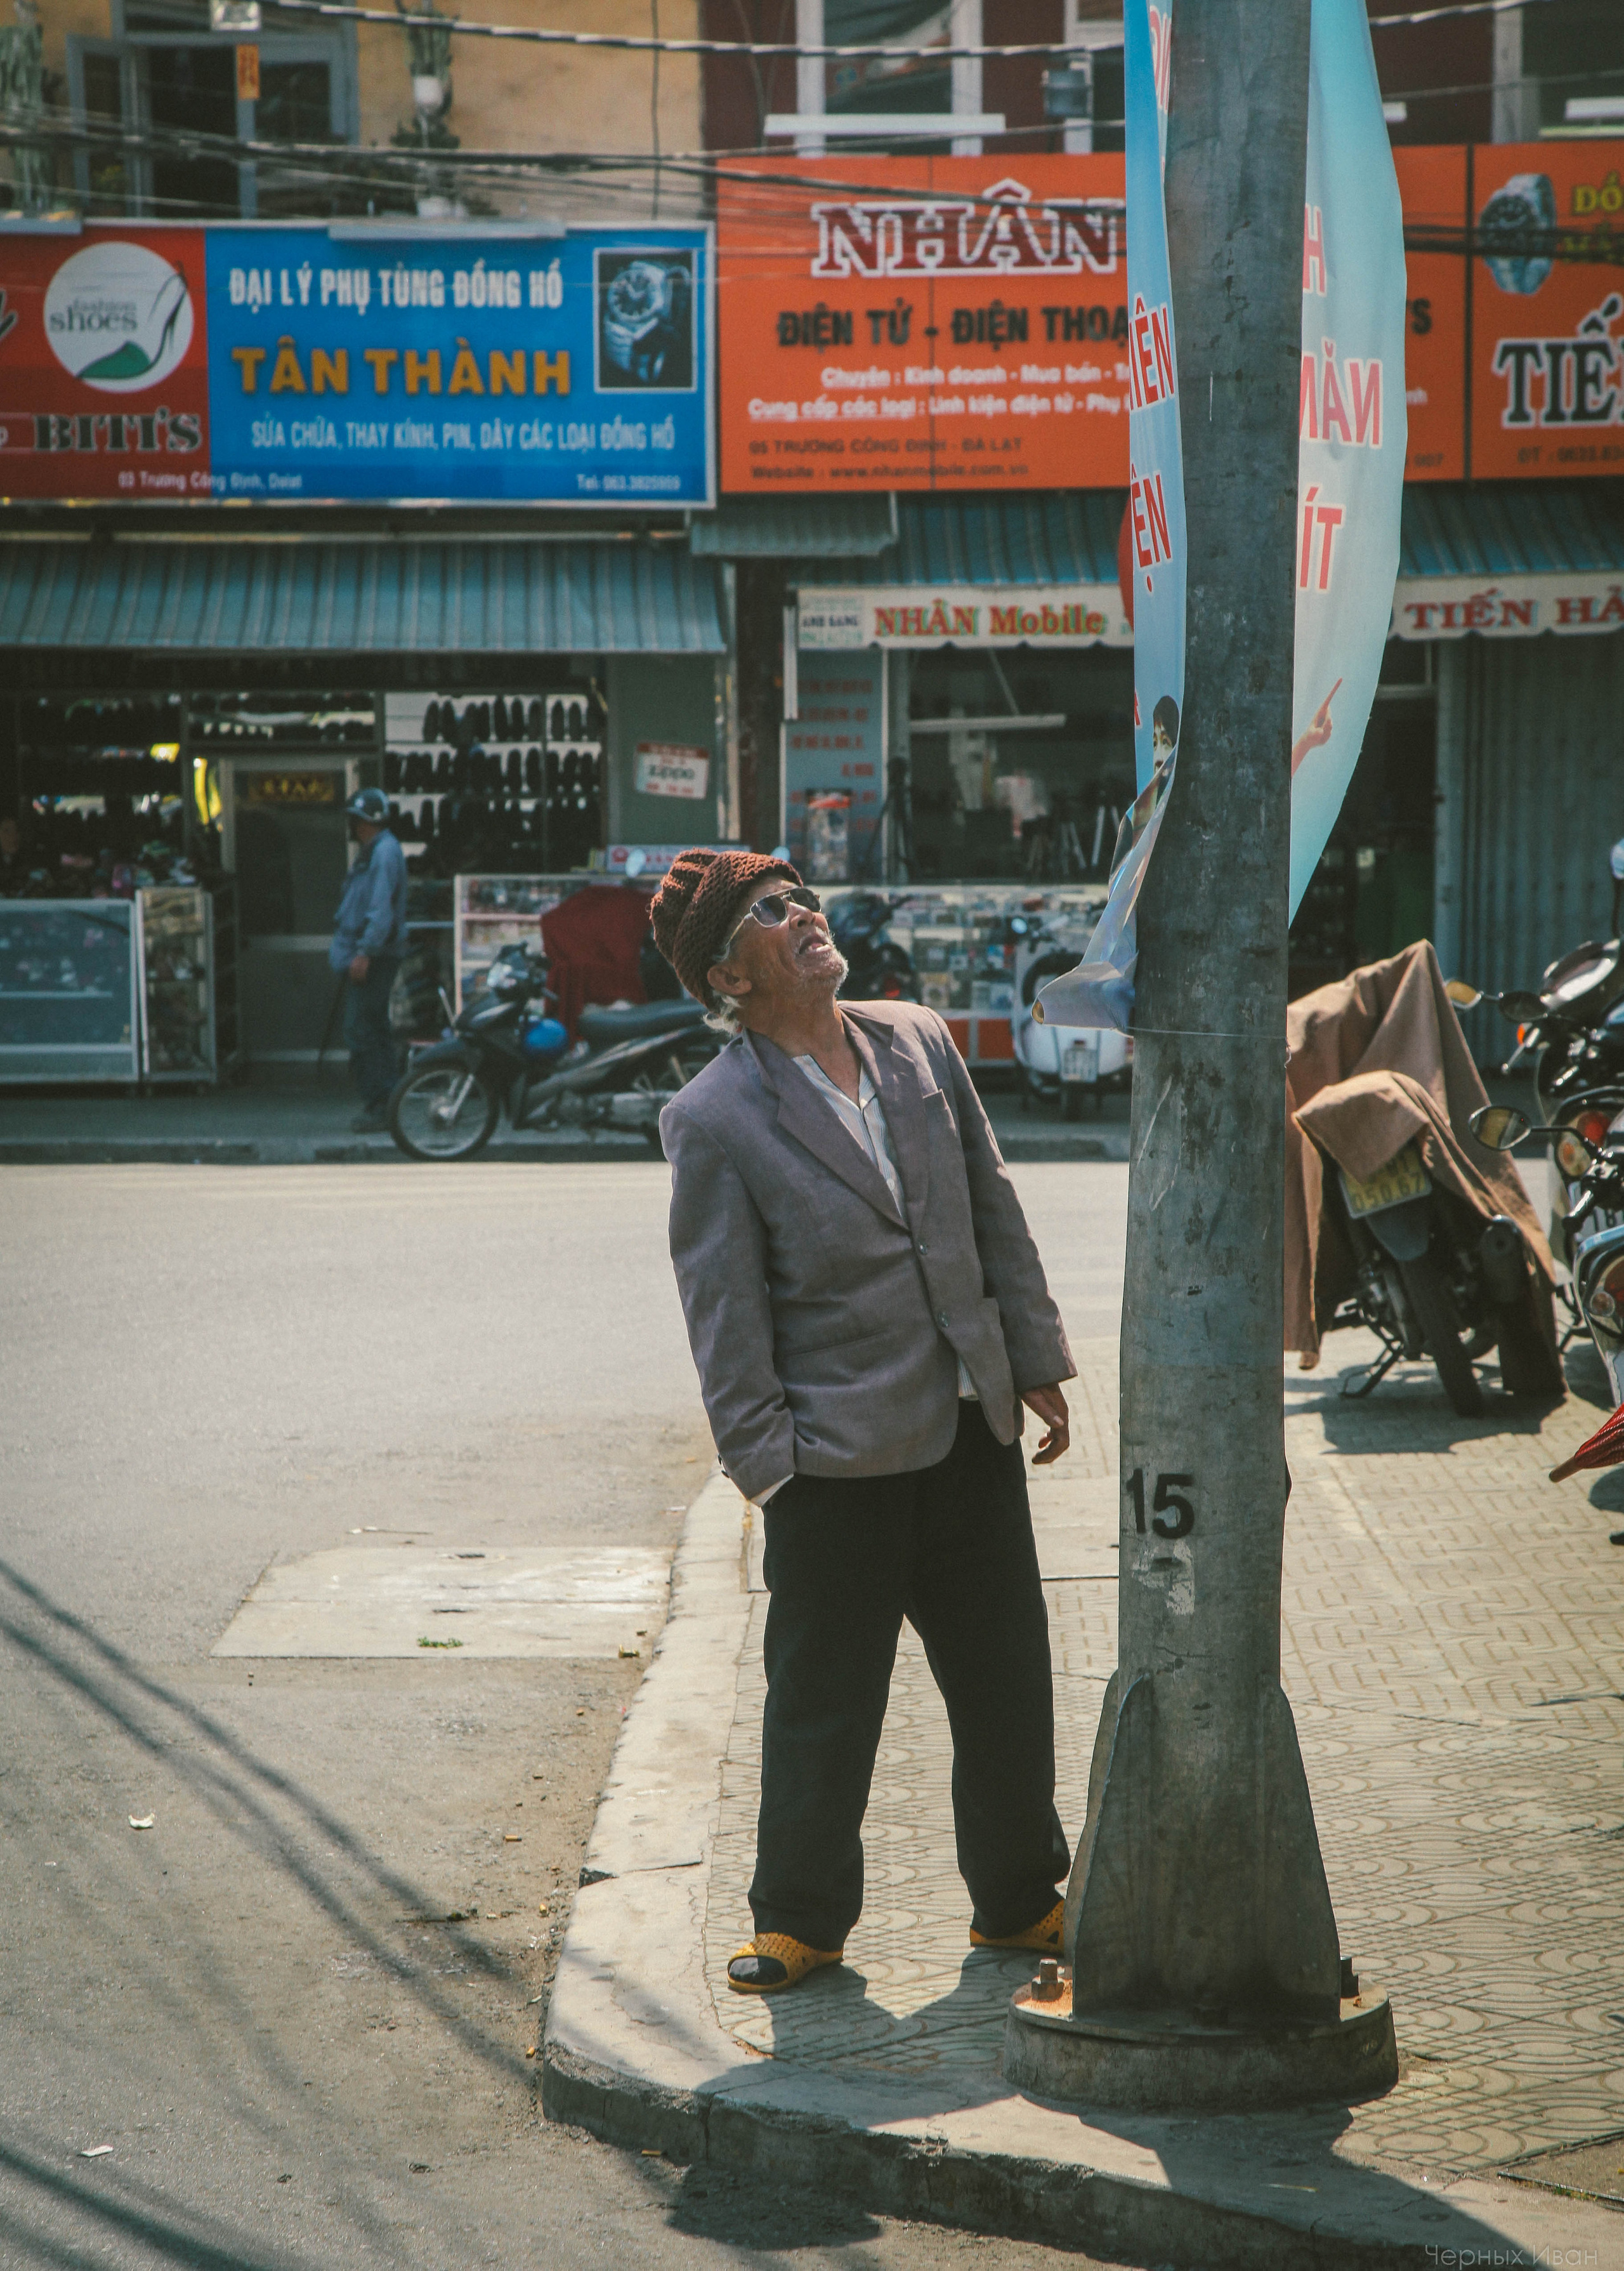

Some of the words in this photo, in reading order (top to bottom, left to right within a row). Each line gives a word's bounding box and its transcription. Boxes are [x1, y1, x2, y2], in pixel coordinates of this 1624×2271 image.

[811, 178, 1118, 277] NHÂN
[229, 268, 272, 313] ĐẠI
[280, 261, 312, 306] LÝ
[320, 268, 370, 315] PHỤ
[49, 305, 138, 332] shoes
[776, 301, 854, 355] ĐIỆN
[865, 296, 914, 346] TỬ
[951, 299, 1028, 352] ĐIỆN
[232, 335, 349, 394] TÂN
[363, 336, 570, 395] THÀNH
[1129, 296, 1174, 411] IÊN
[1493, 293, 1624, 428] TIẾ
[346, 421, 389, 449] THAY
[874, 598, 980, 637] NHÂN
[988, 603, 1108, 636] Mobile
[1404, 587, 1540, 630] TIẾN
[1126, 1468, 1195, 1539] 15
